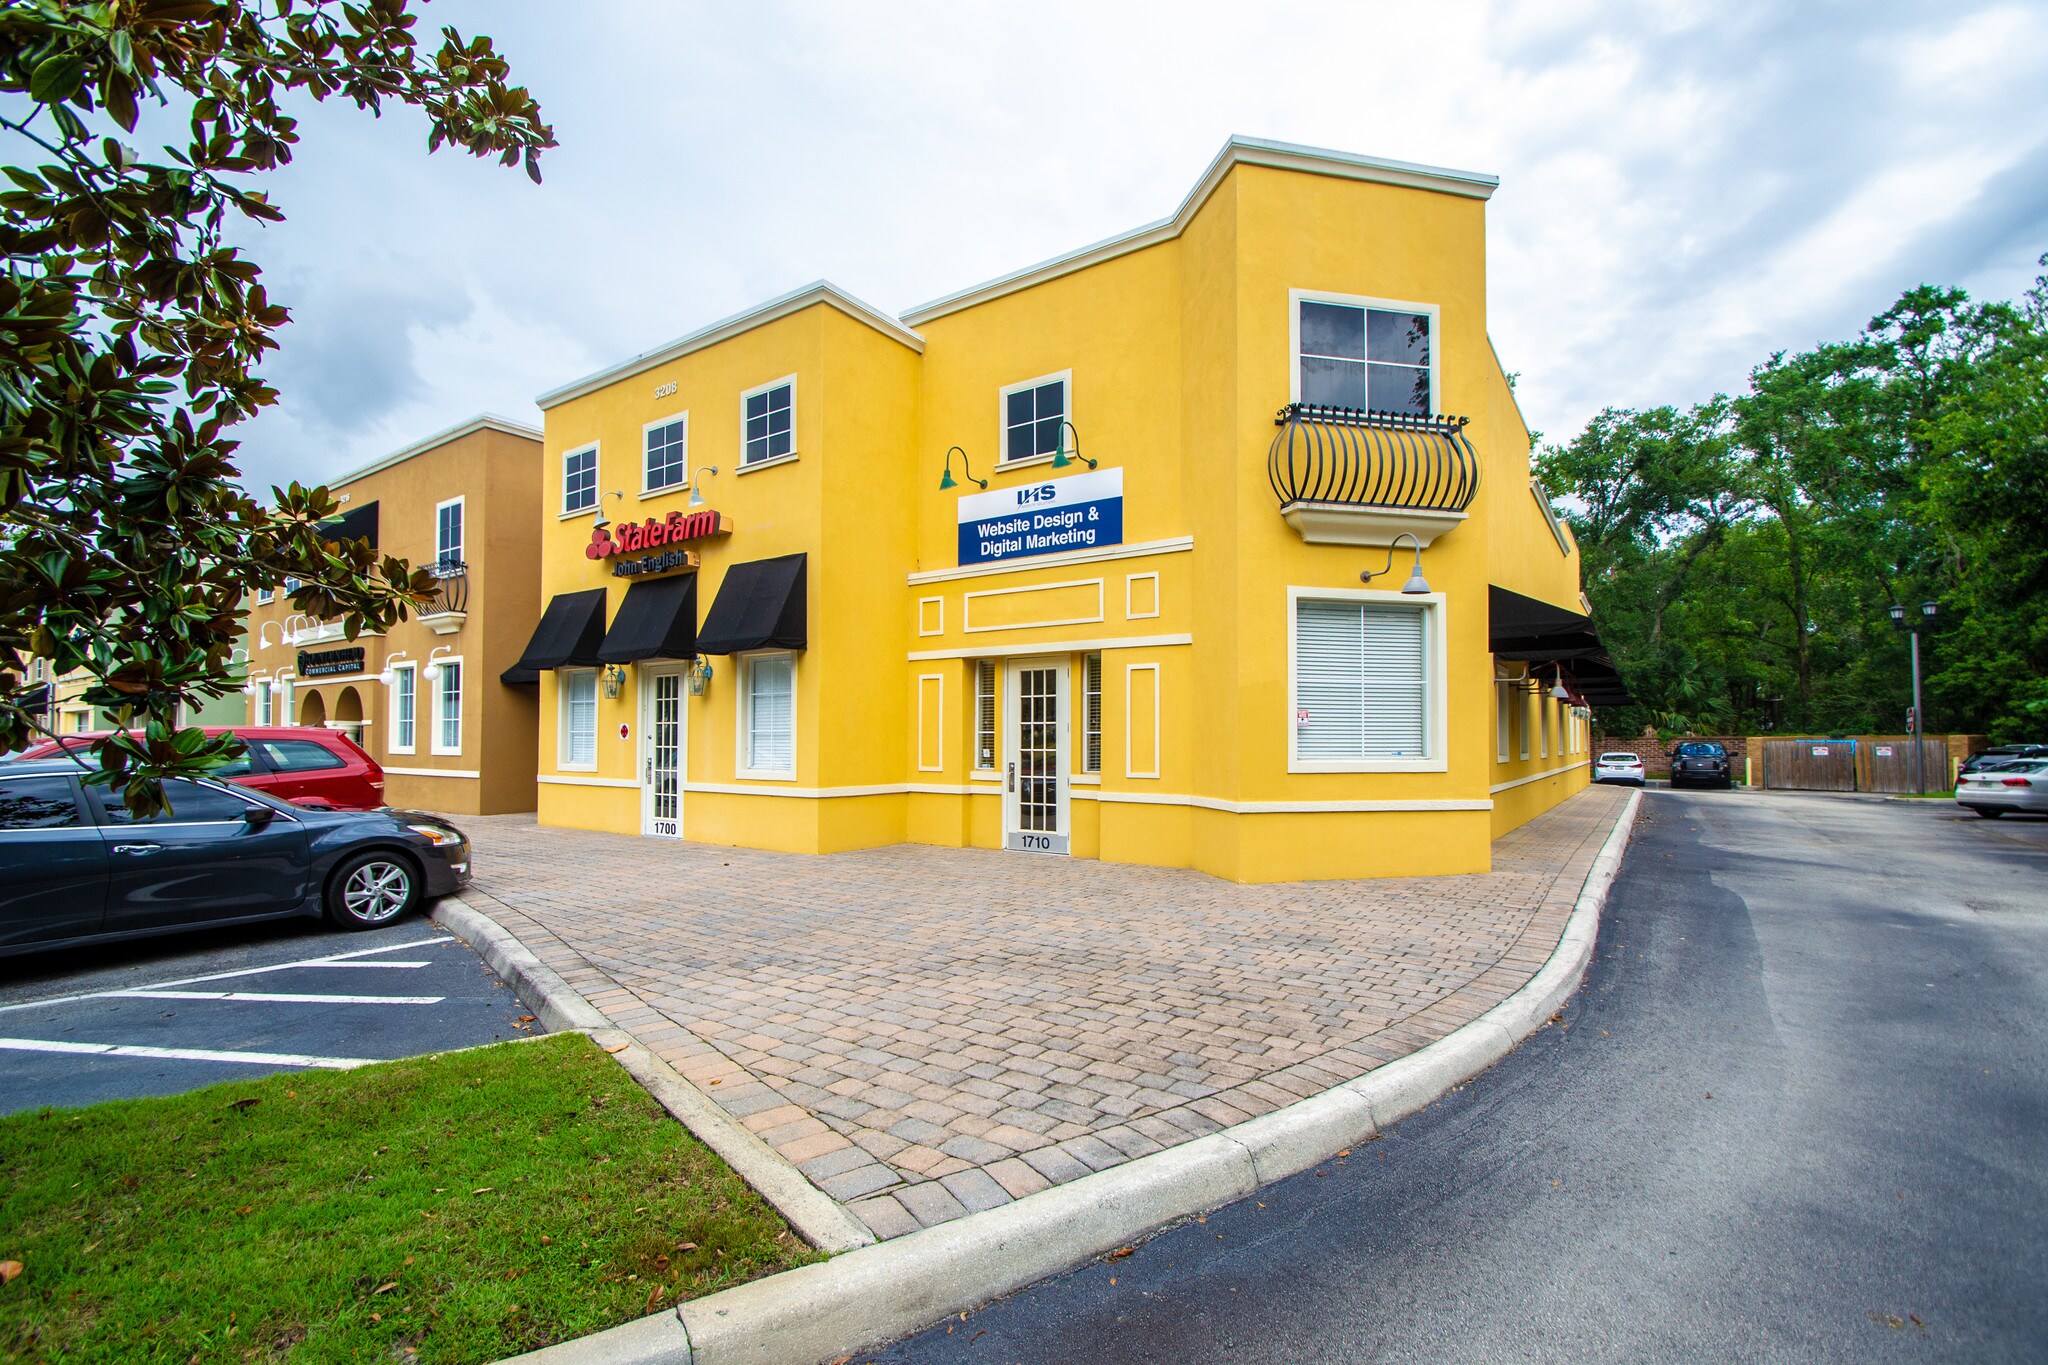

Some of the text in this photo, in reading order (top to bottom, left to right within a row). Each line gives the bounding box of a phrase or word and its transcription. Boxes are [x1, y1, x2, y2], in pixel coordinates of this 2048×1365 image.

[654, 381, 677, 400] 3208
[1017, 484, 1056, 505] IHS
[977, 506, 1100, 538] Website Design &
[980, 529, 1096, 557] Digital Marketing
[612, 549, 684, 577] John English
[655, 822, 677, 835] 1700
[1021, 835, 1050, 849] 1710
